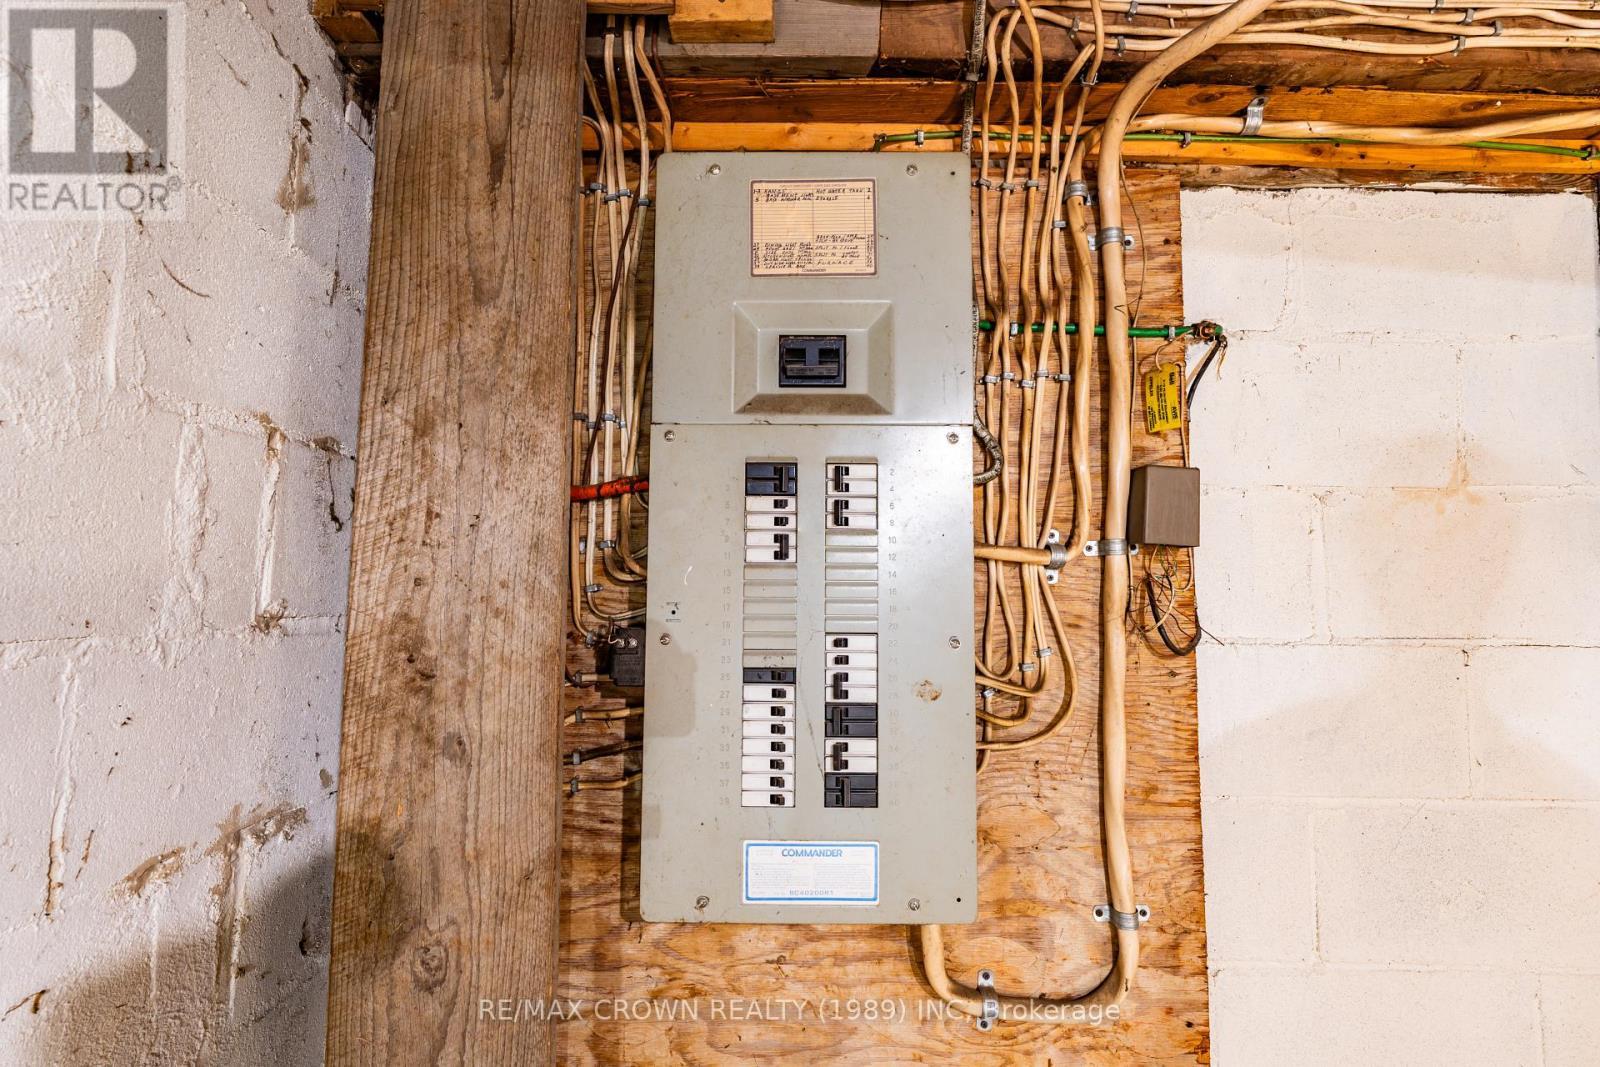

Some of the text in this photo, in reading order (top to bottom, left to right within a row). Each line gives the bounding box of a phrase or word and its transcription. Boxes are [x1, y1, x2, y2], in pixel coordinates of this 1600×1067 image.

[888, 468, 896, 476] 2
[888, 502, 896, 510] 6
[888, 519, 896, 527] 8
[888, 536, 897, 544] 10
[888, 552, 897, 561] 12
[888, 570, 897, 578] 14
[781, 848, 843, 858] COMMANDER
